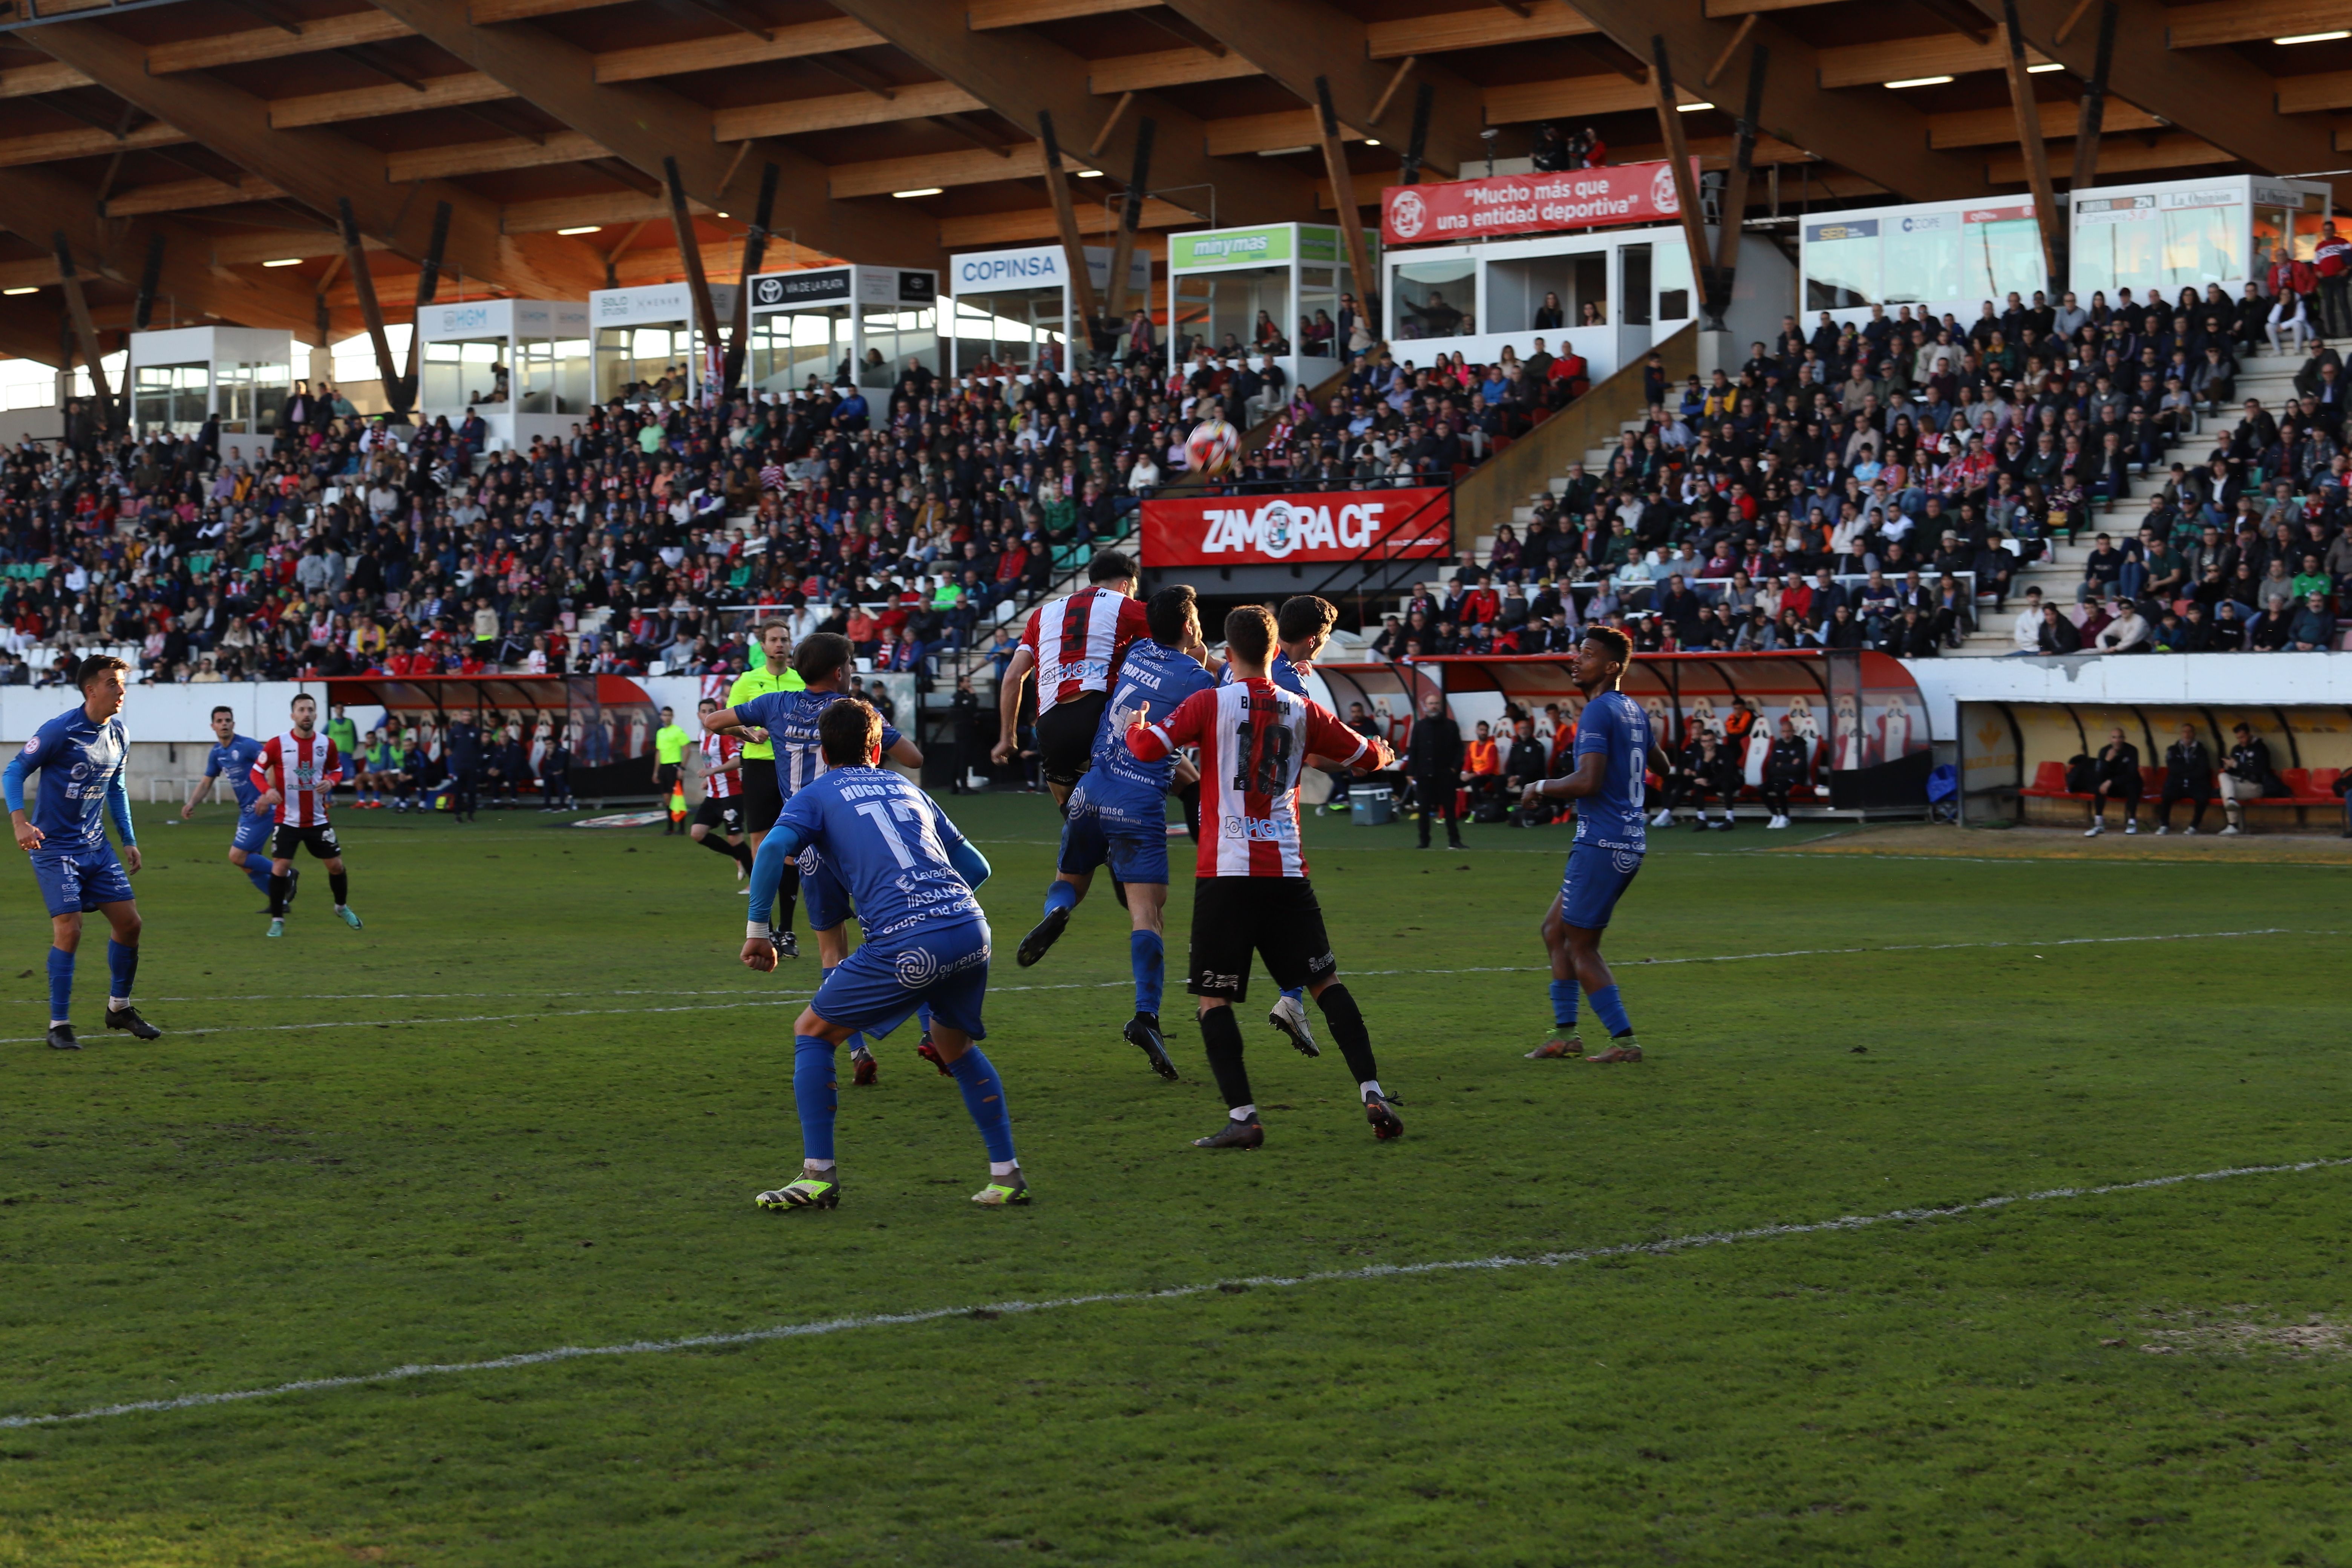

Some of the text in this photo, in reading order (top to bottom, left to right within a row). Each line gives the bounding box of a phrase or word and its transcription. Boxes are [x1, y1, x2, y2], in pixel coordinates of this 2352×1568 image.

[1464, 179, 1609, 205] “Mucho más que
[1437, 195, 1638, 230] una entidad deportiva”
[1819, 227, 1846, 240] SER
[962, 256, 1055, 282] COPINSA
[799, 281, 810, 292] DE
[810, 280, 821, 292] LA
[822, 278, 844, 290] PLATA
[456, 309, 487, 326] HGM
[1202, 499, 1384, 558] ZAMORA CF
[1063, 607, 1087, 651] 3
[1059, 660, 1109, 678] HGM
[1121, 662, 1161, 690] PORTELA
[1241, 696, 1290, 715] BALDRICH
[784, 725, 812, 740] ALEX
[1233, 720, 1291, 796] 18
[1629, 747, 1645, 808] 8
[840, 784, 886, 802] HUGO
[1086, 804, 1124, 816] ourense
[854, 798, 951, 869] 17
[1598, 839, 1631, 850] Grupo
[882, 913, 926, 934] Grupo
[929, 905, 950, 917] Cid
[939, 944, 988, 974] ourense
